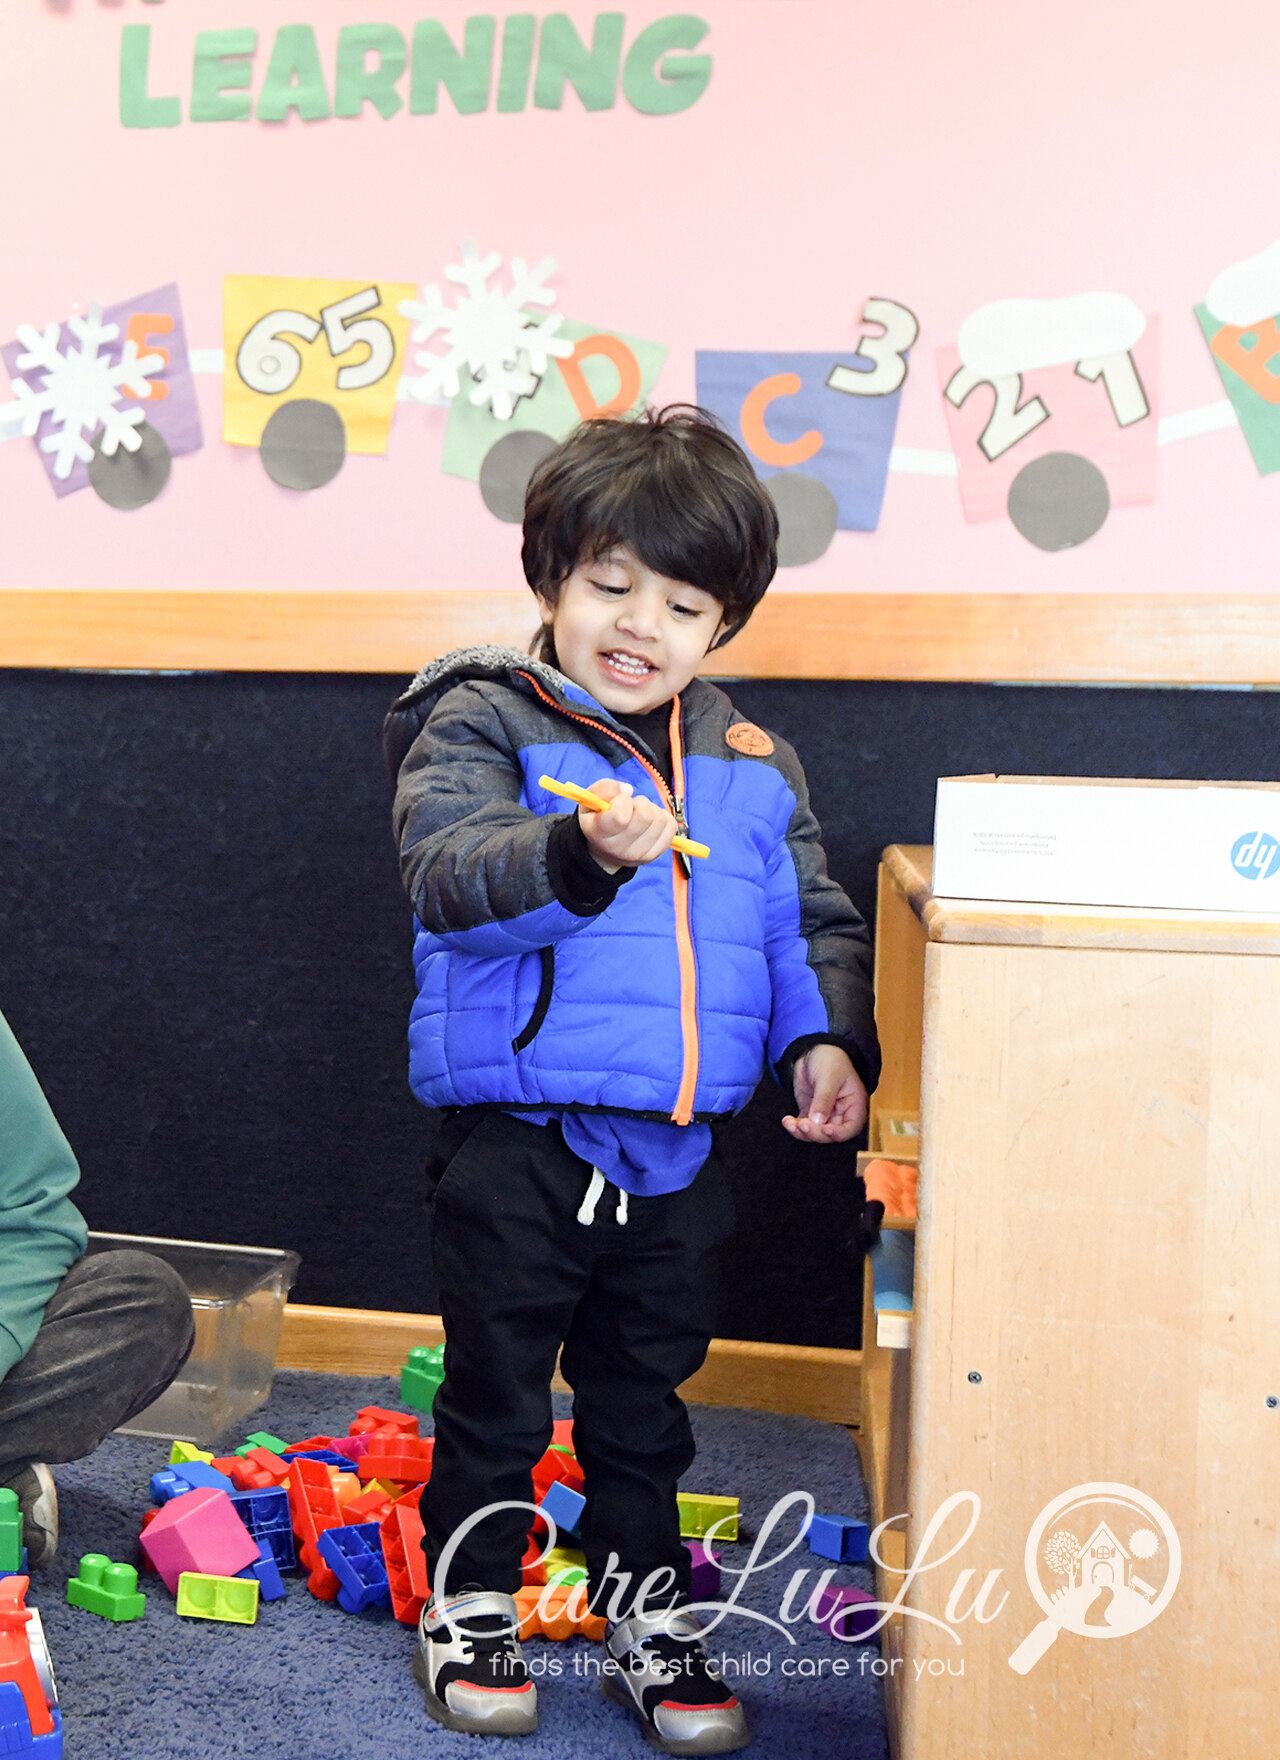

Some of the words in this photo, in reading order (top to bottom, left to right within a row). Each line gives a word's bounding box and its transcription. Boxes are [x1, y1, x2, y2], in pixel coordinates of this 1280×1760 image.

[118, 11, 713, 129] LEARNING
[555, 333, 642, 422] D
[827, 296, 920, 397] 3
[1076, 350, 1151, 427] 1
[740, 372, 824, 466] C
[944, 365, 1050, 461] 2
[1233, 831, 1279, 880] hp
